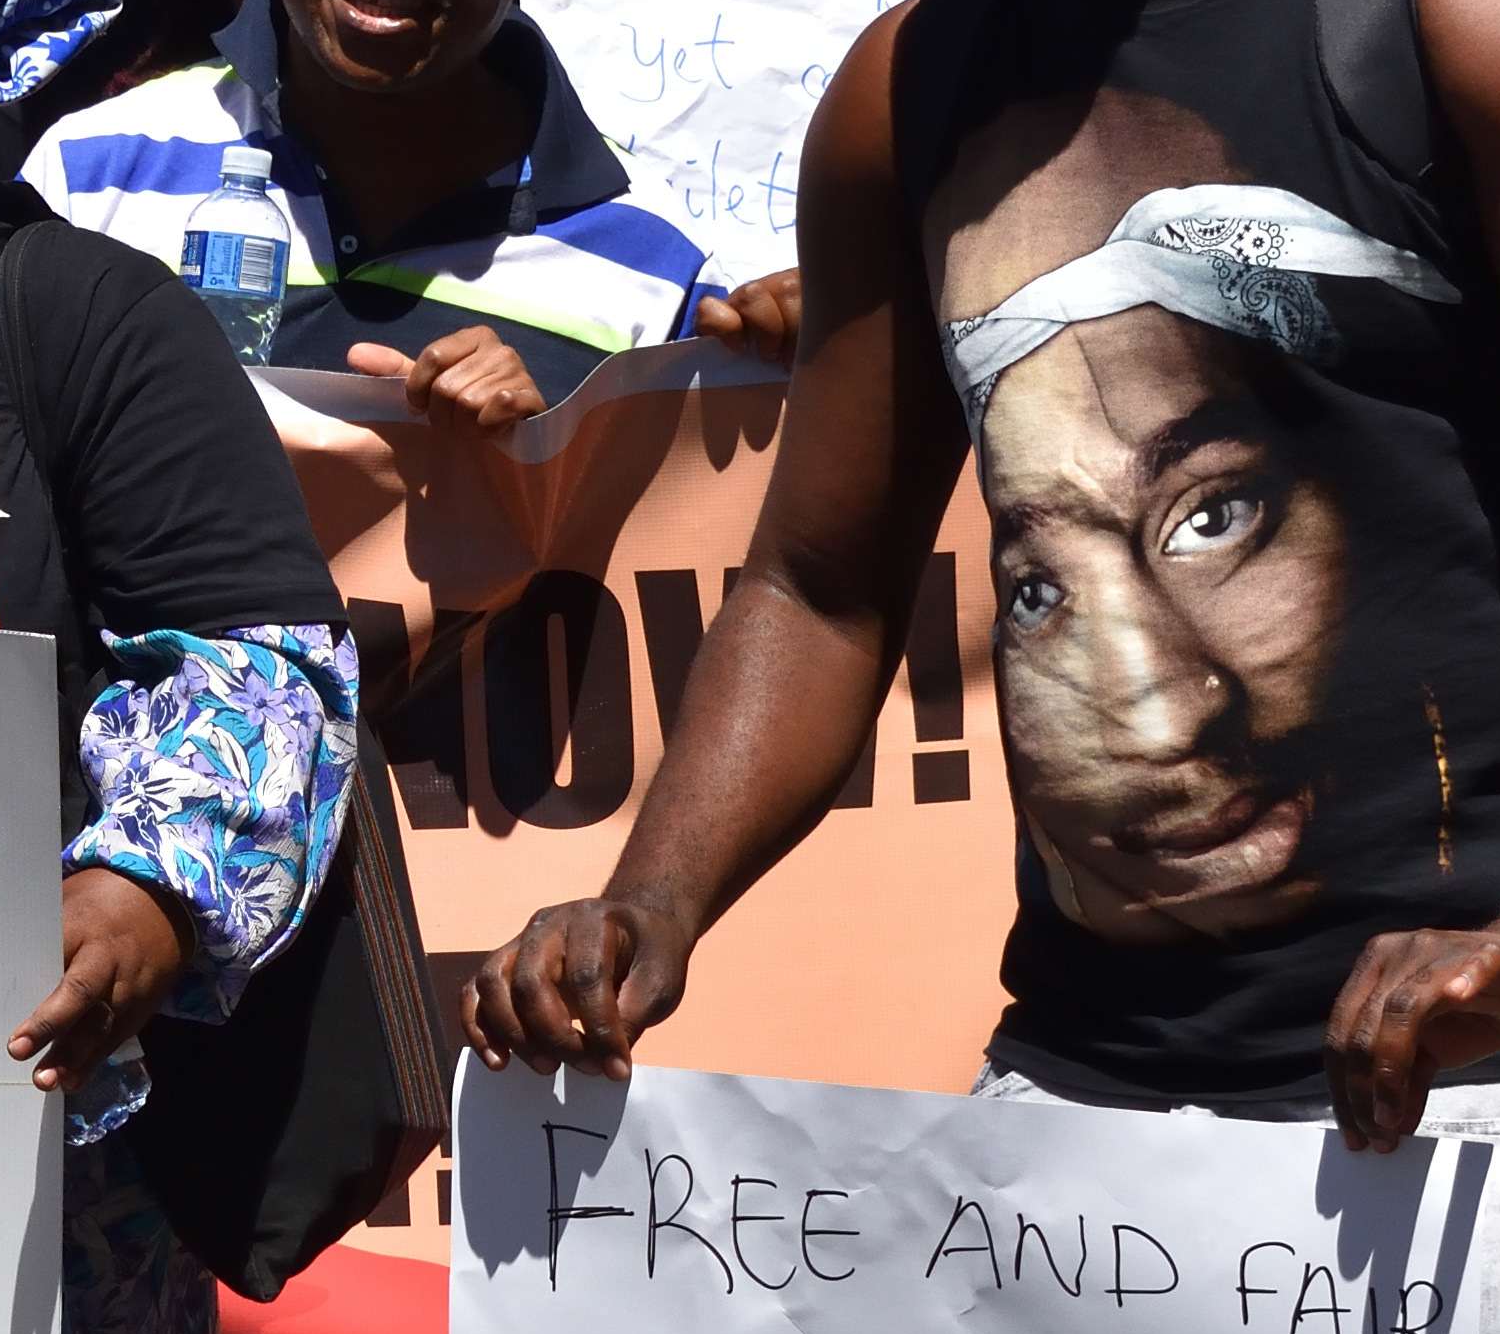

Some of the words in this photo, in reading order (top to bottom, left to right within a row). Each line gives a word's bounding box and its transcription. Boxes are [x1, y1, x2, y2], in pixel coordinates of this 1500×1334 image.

[618, 13, 736, 104] yet
[540, 1120, 861, 1293] FREE
[924, 1195, 1181, 1308] AND
